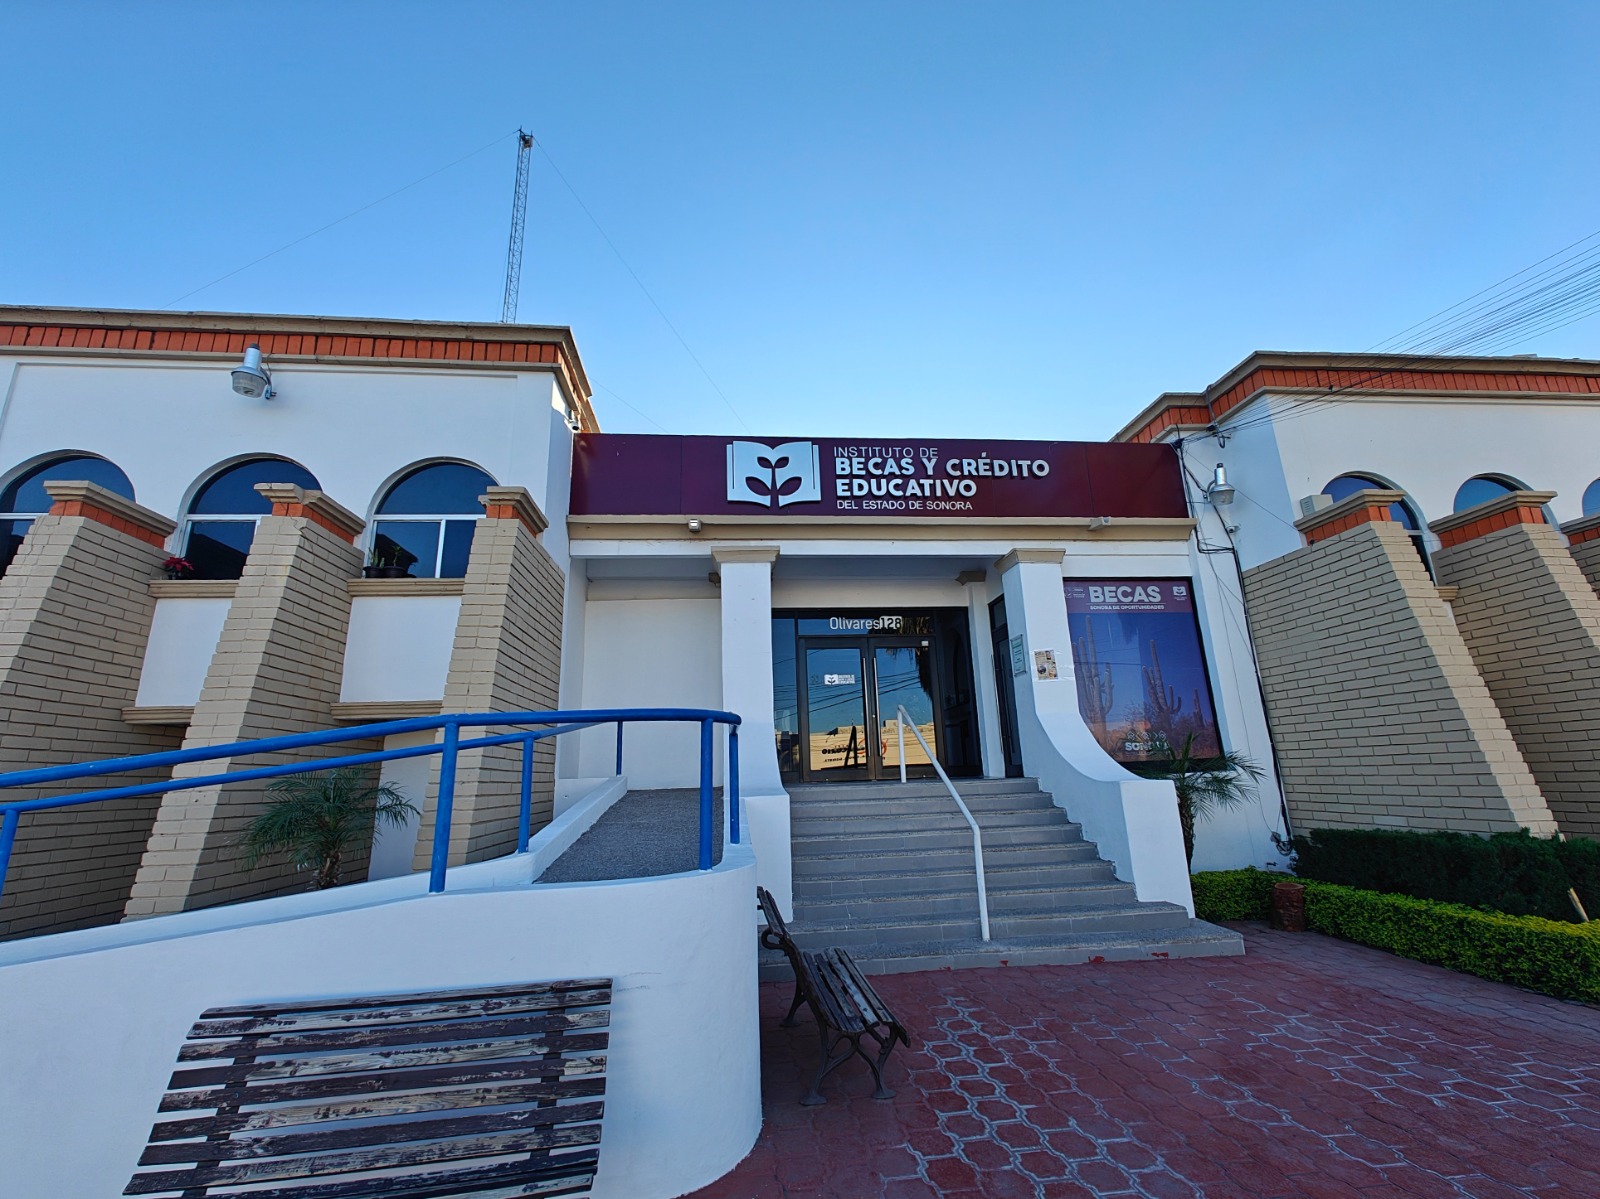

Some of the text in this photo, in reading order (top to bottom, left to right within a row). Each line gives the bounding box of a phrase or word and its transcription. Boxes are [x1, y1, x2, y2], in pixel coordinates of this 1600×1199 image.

[833, 446, 939, 459] INSTITUTO DE
[835, 452, 1050, 477] BECAS Y CRÉDITO
[836, 478, 977, 497] EDUCATIVO
[837, 499, 973, 511] DEL ESTADO DE SONORA
[1088, 585, 1162, 603] BECAS
